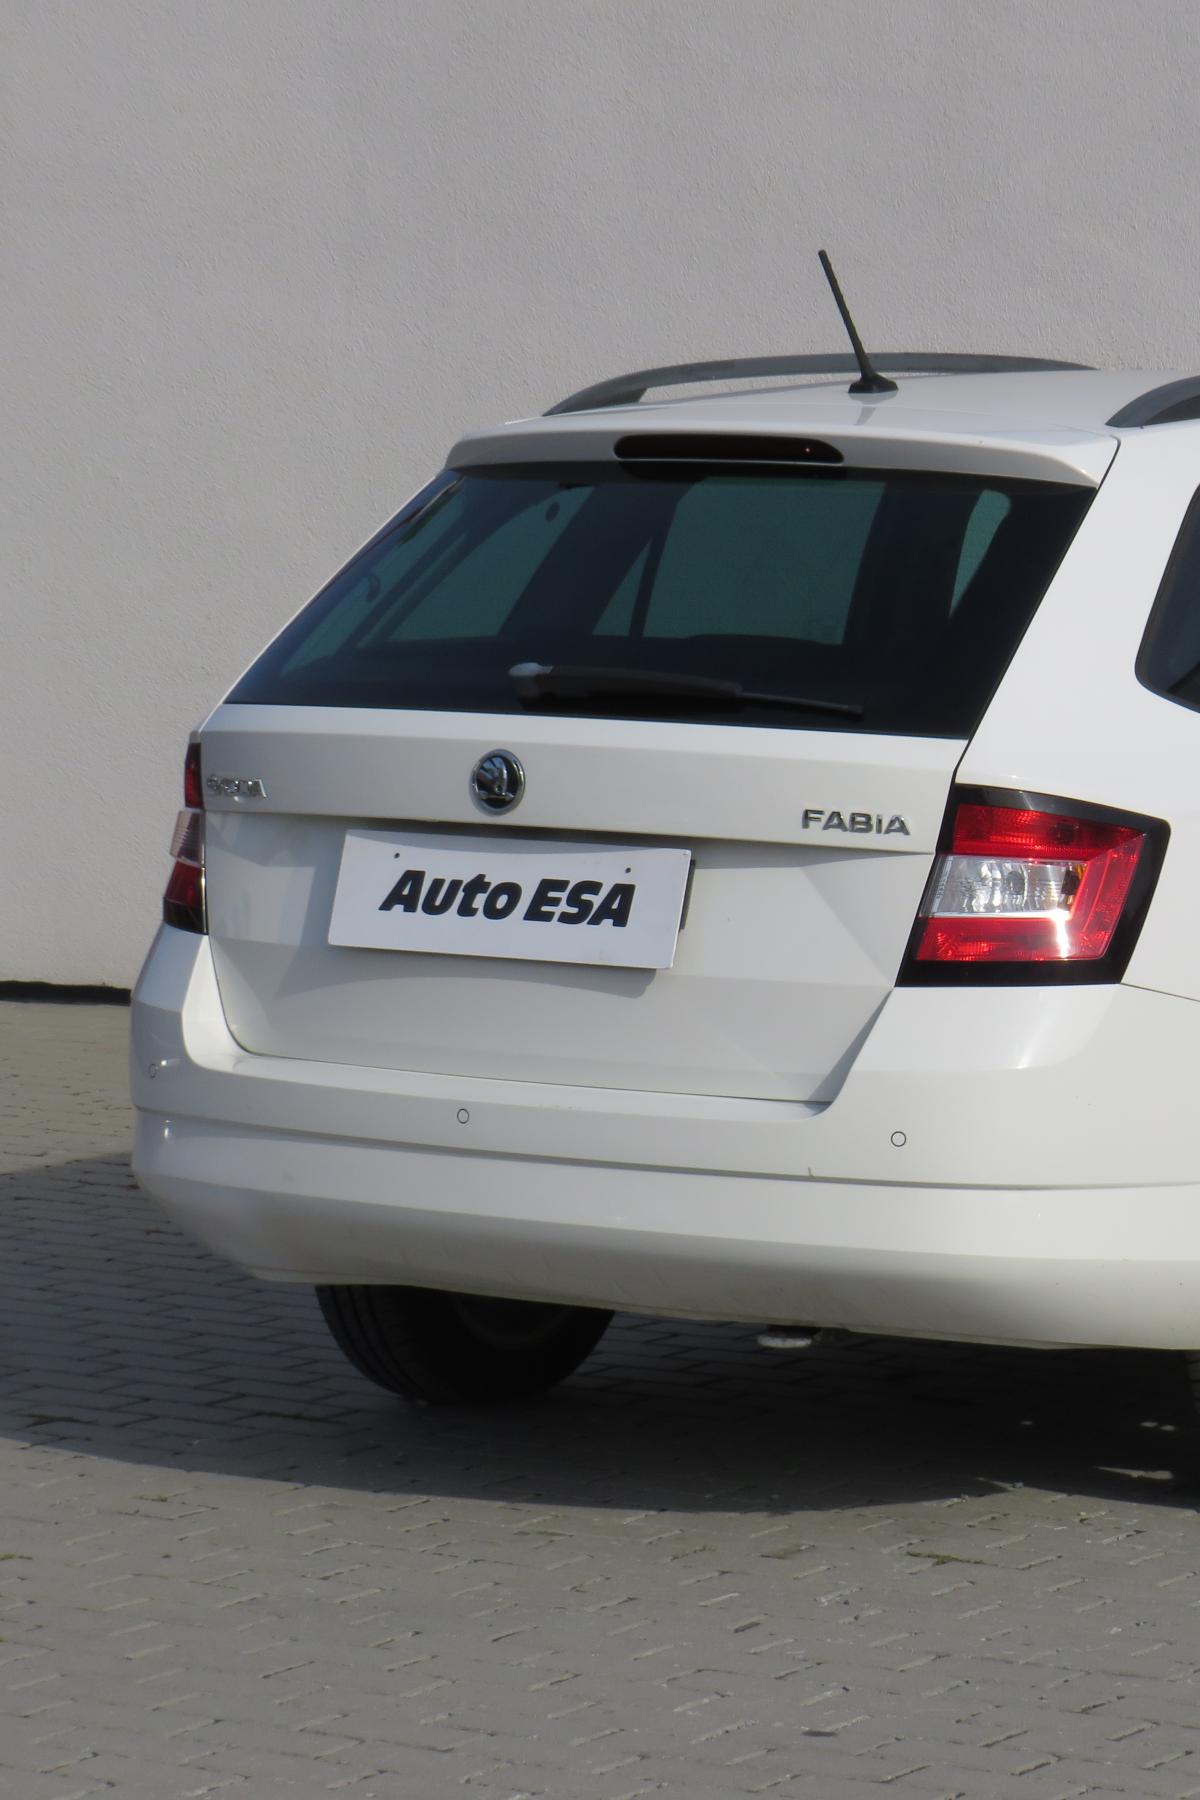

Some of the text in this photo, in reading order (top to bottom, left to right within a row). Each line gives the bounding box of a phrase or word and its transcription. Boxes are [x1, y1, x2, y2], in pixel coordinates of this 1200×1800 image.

[801, 808, 911, 836] FABIA
[378, 869, 637, 928] Auto ESA
